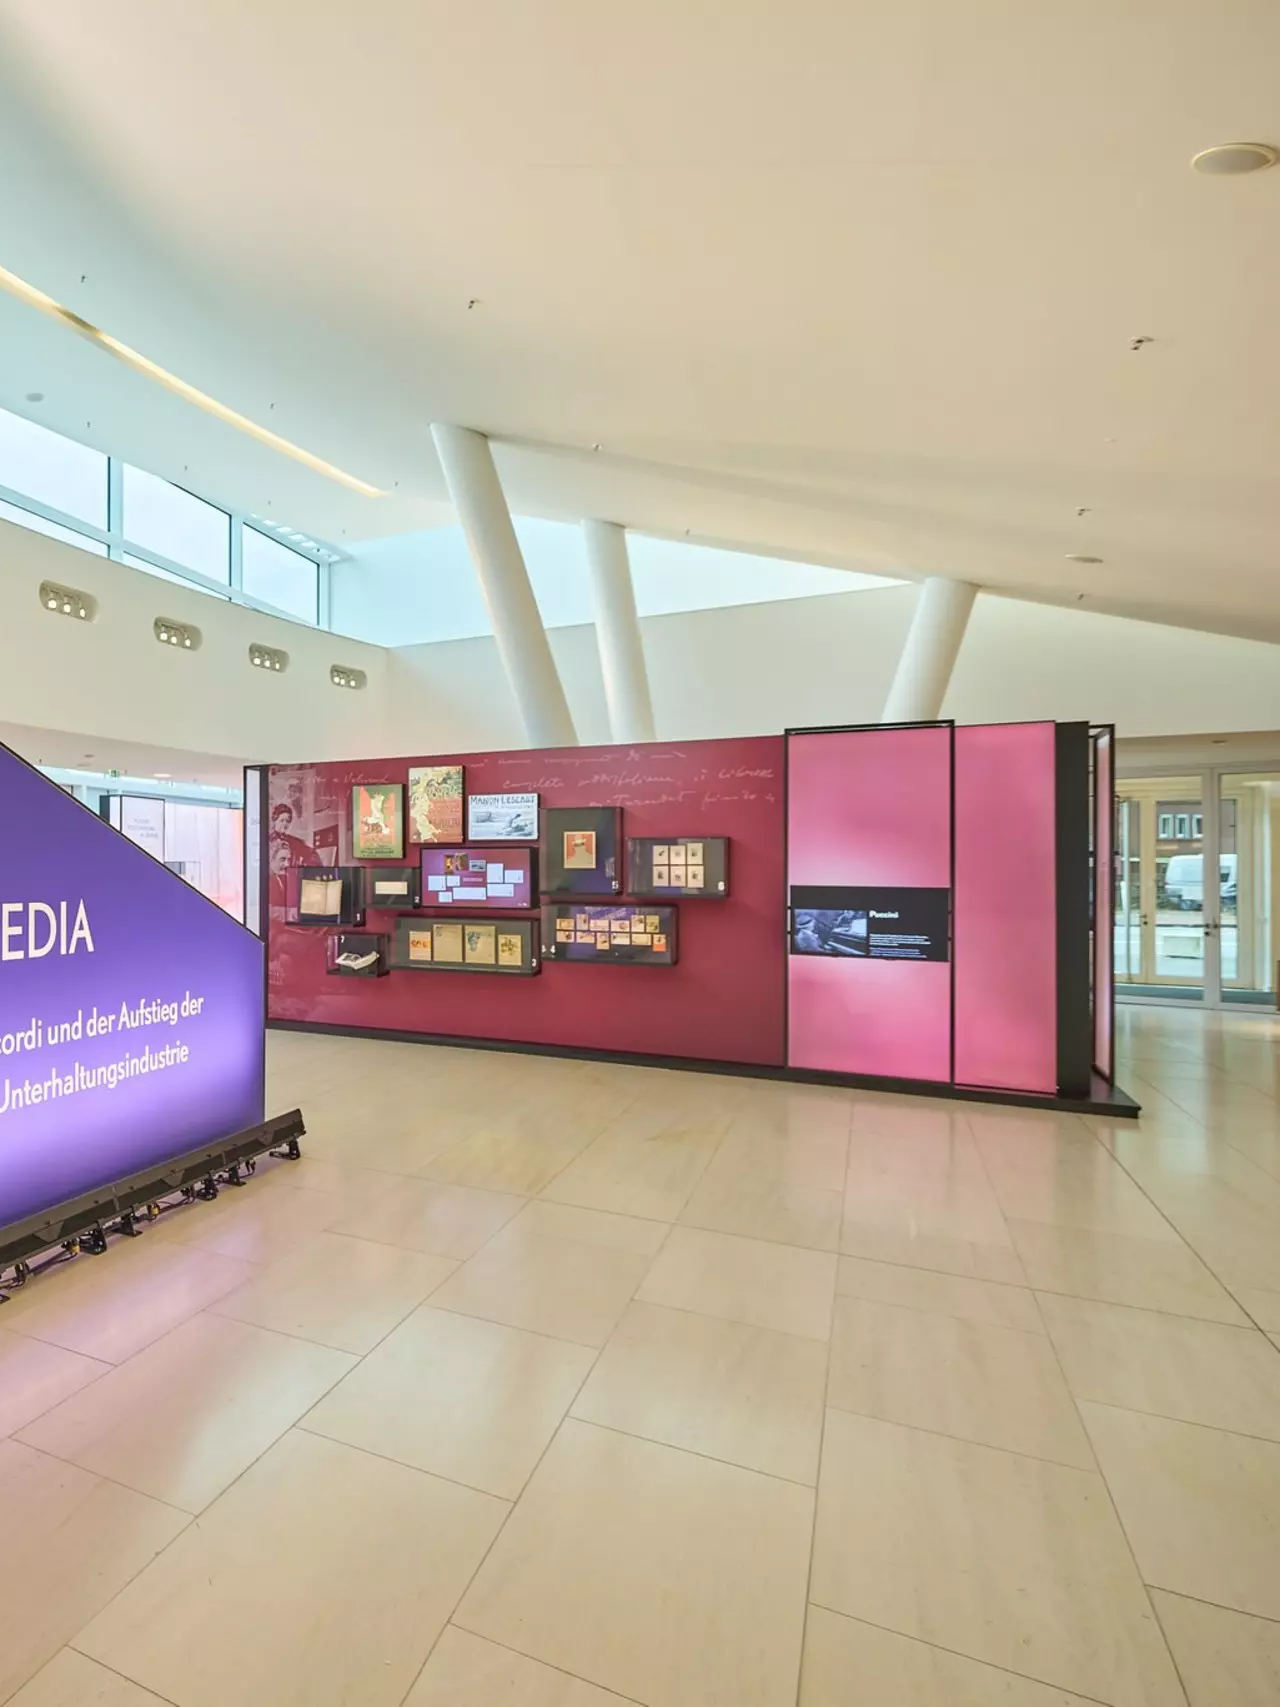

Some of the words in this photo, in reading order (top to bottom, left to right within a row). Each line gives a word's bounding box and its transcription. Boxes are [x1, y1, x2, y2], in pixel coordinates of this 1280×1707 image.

[612, 880, 619, 890] 5
[869, 909, 899, 919] Puccini
[531, 958, 537, 968] 3
[47, 1009, 83, 1046] und
[86, 1007, 117, 1037] der
[116, 998, 179, 1031] Aufstieg
[180, 991, 205, 1017] der
